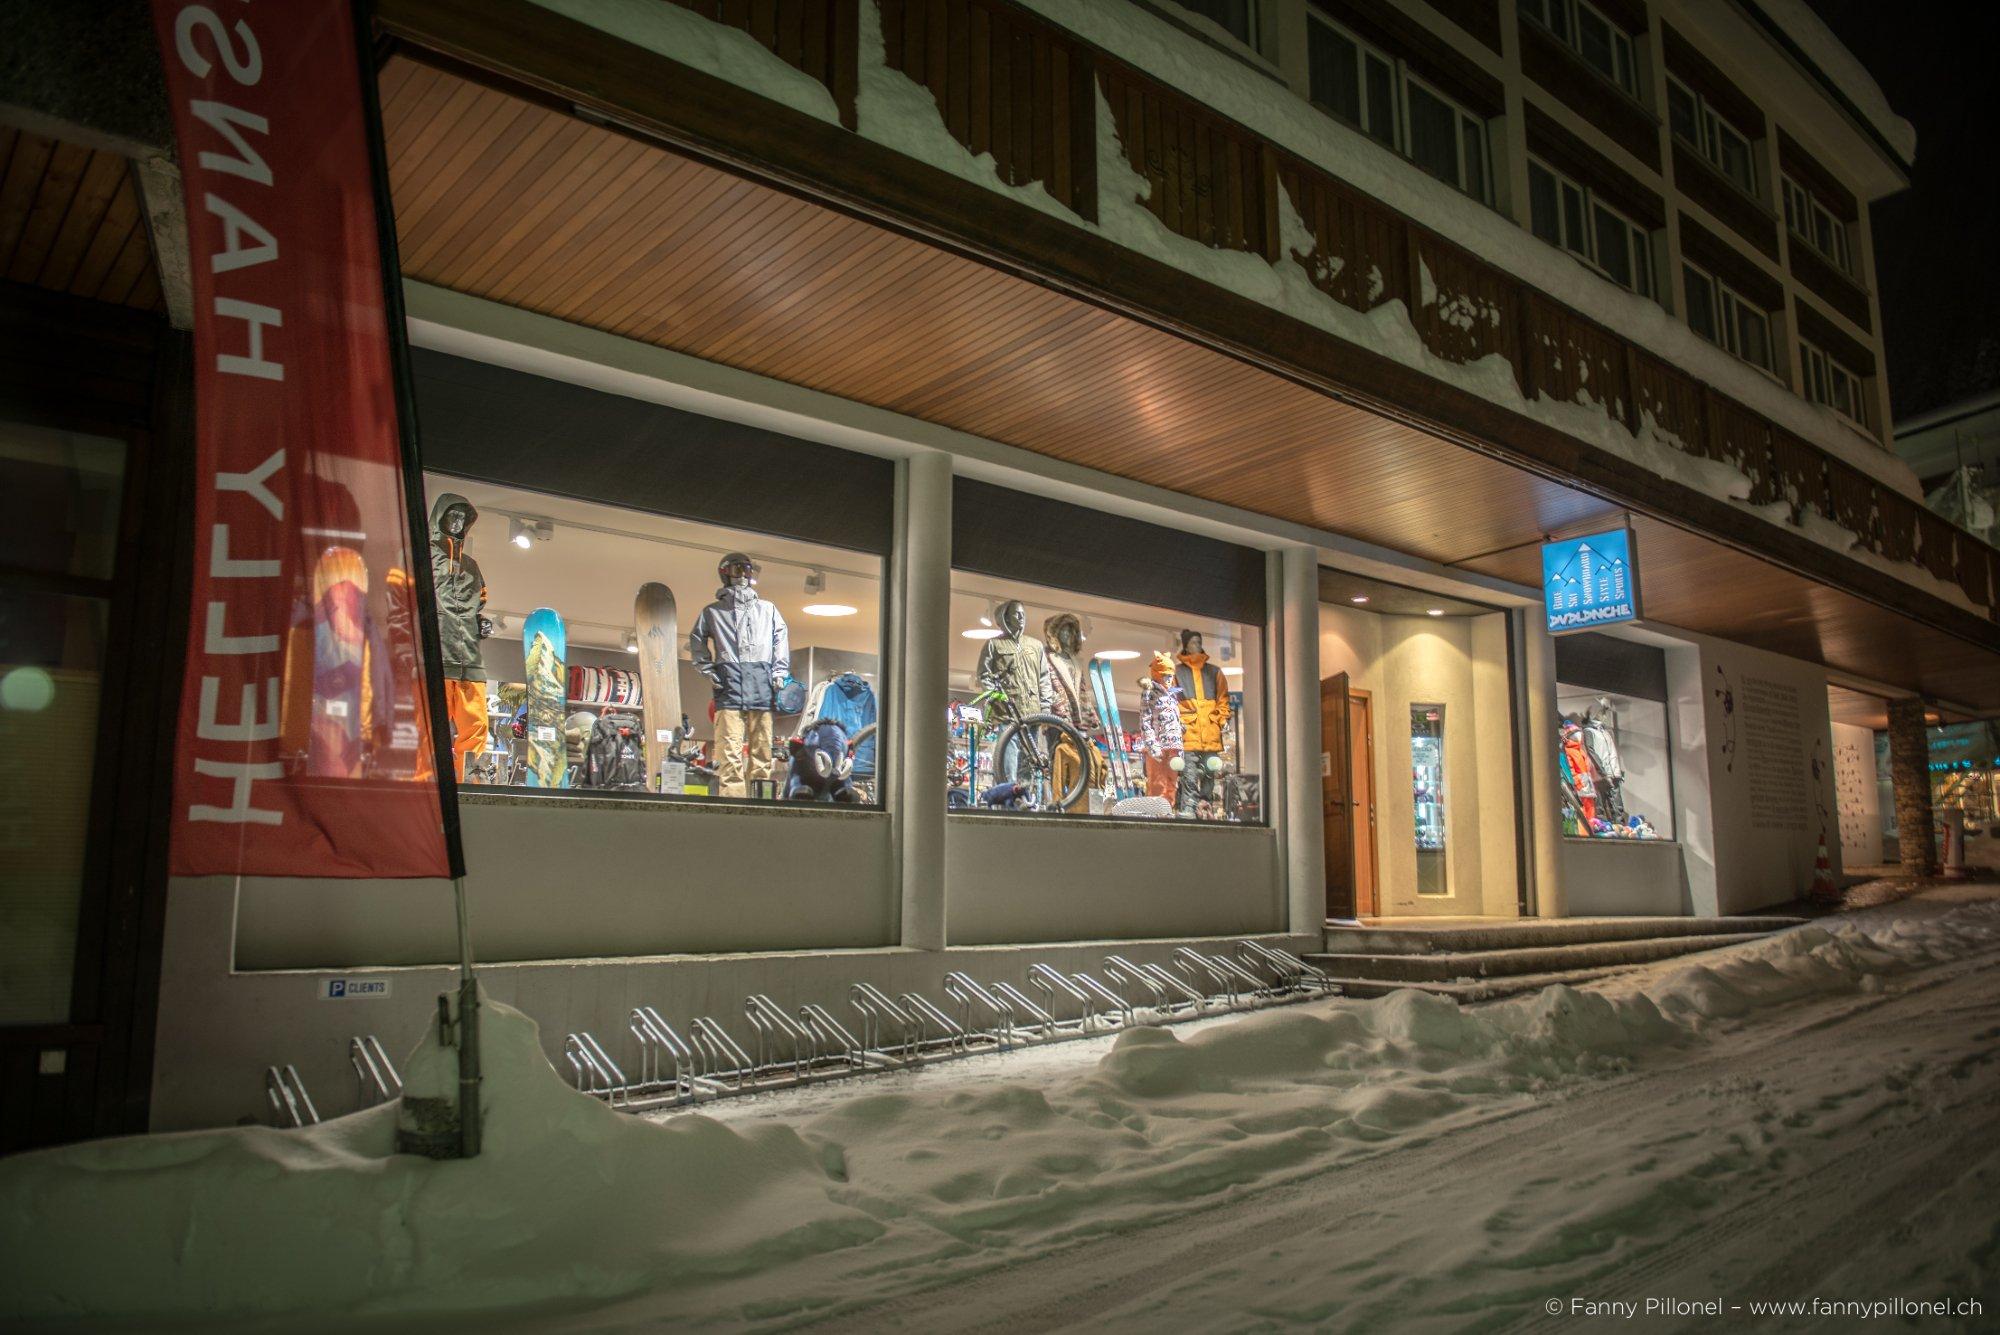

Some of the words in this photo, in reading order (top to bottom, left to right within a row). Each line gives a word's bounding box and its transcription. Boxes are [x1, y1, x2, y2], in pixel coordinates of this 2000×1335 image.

[1600, 577, 1610, 602] STYLE
[1614, 567, 1625, 600] SPORTS
[1568, 593, 1578, 608] SKI
[1549, 604, 1631, 627] AVALANCHE
[332, 982, 344, 995] P
[349, 982, 384, 993] CLIENTS
